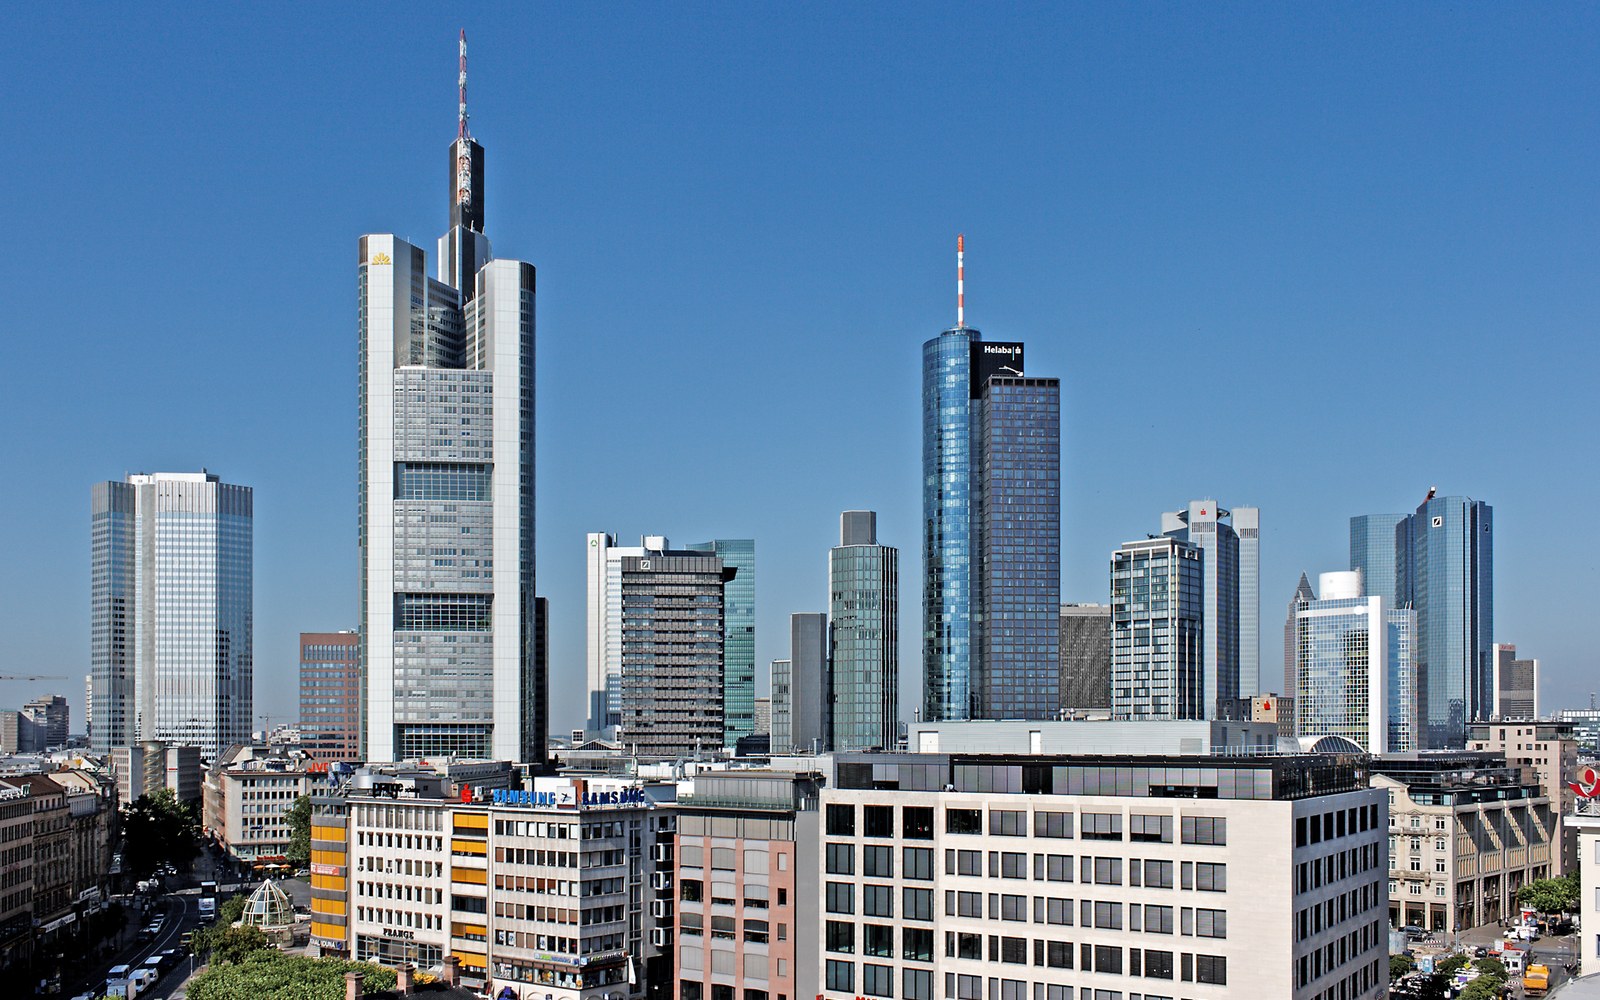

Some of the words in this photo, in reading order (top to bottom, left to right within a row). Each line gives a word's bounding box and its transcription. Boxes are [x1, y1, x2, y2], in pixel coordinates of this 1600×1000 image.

[984, 345, 1012, 354] Helaba
[493, 788, 556, 805] SAMSUNG
[582, 788, 645, 805] SAMSUNG
[383, 927, 414, 940] PRANGE
